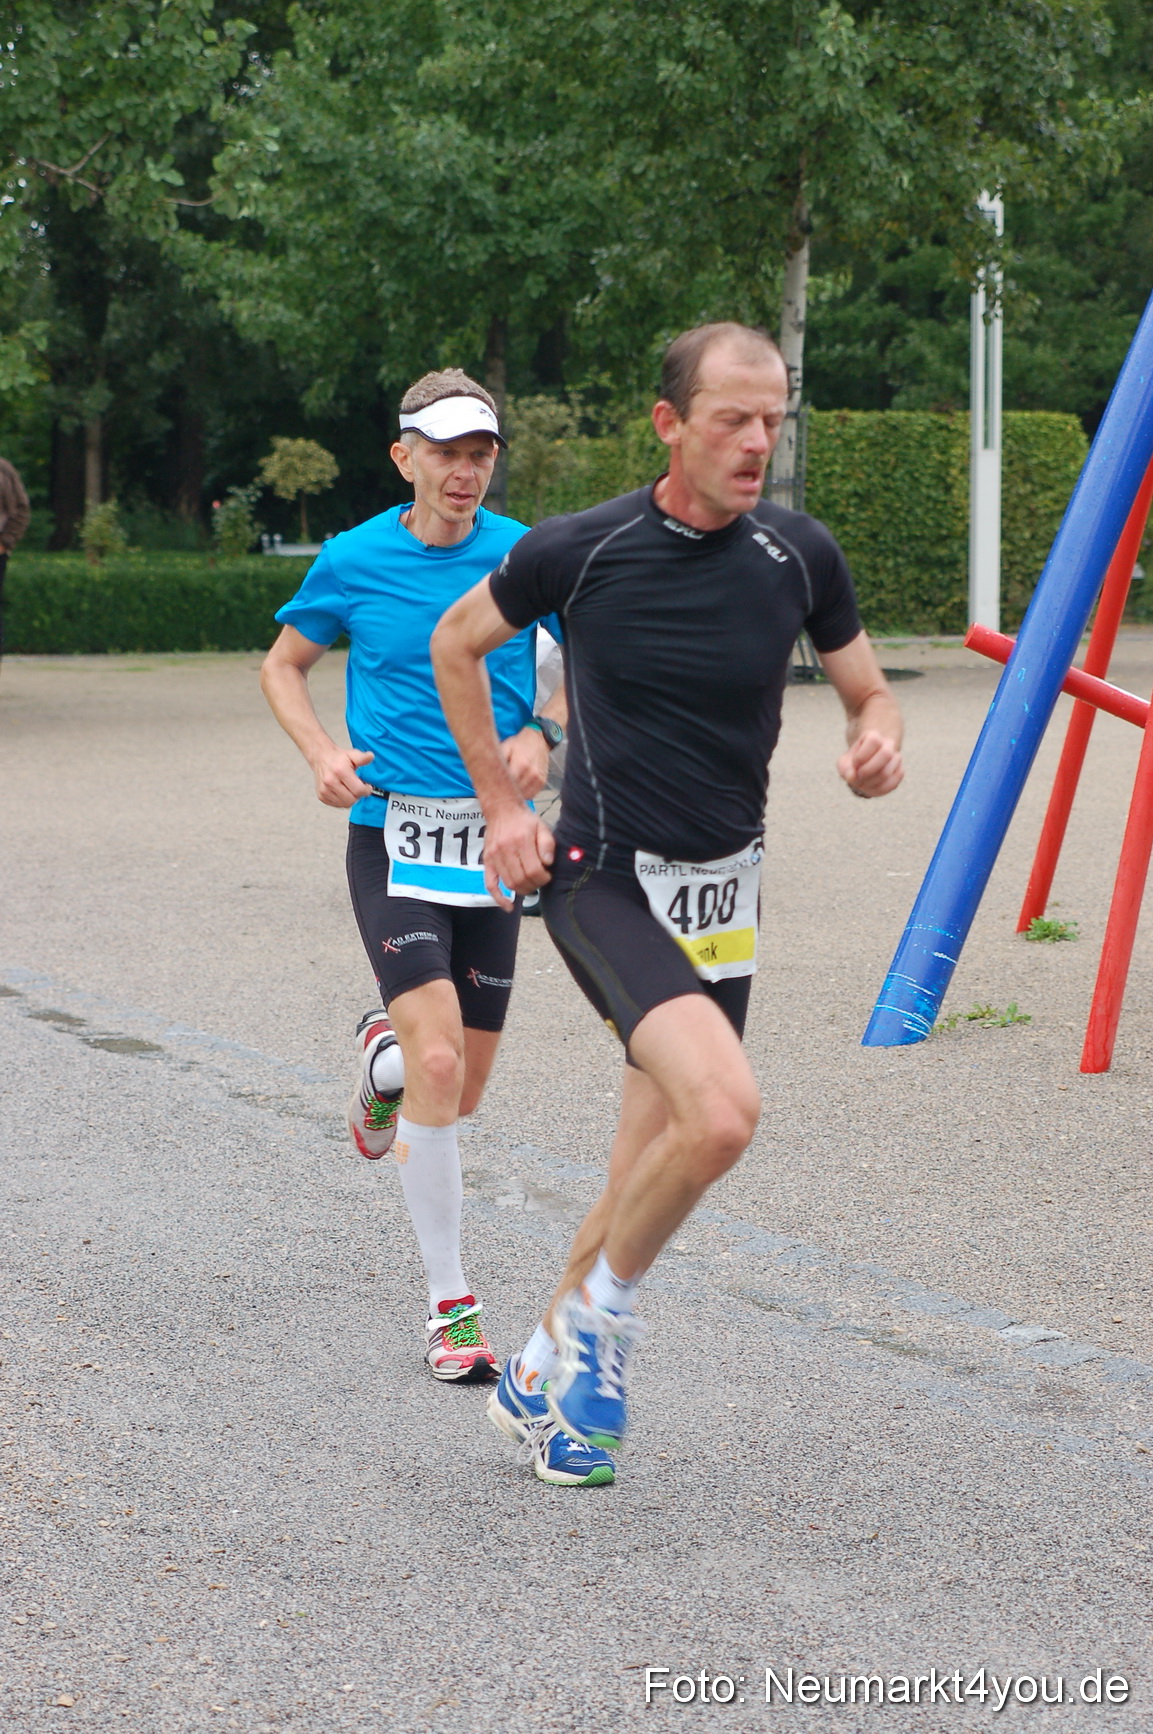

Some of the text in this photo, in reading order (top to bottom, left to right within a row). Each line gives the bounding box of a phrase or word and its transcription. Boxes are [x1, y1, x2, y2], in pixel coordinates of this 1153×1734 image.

[391, 801, 432, 818] PARTL
[640, 864, 687, 877] PARTL
[667, 877, 739, 934] 400
